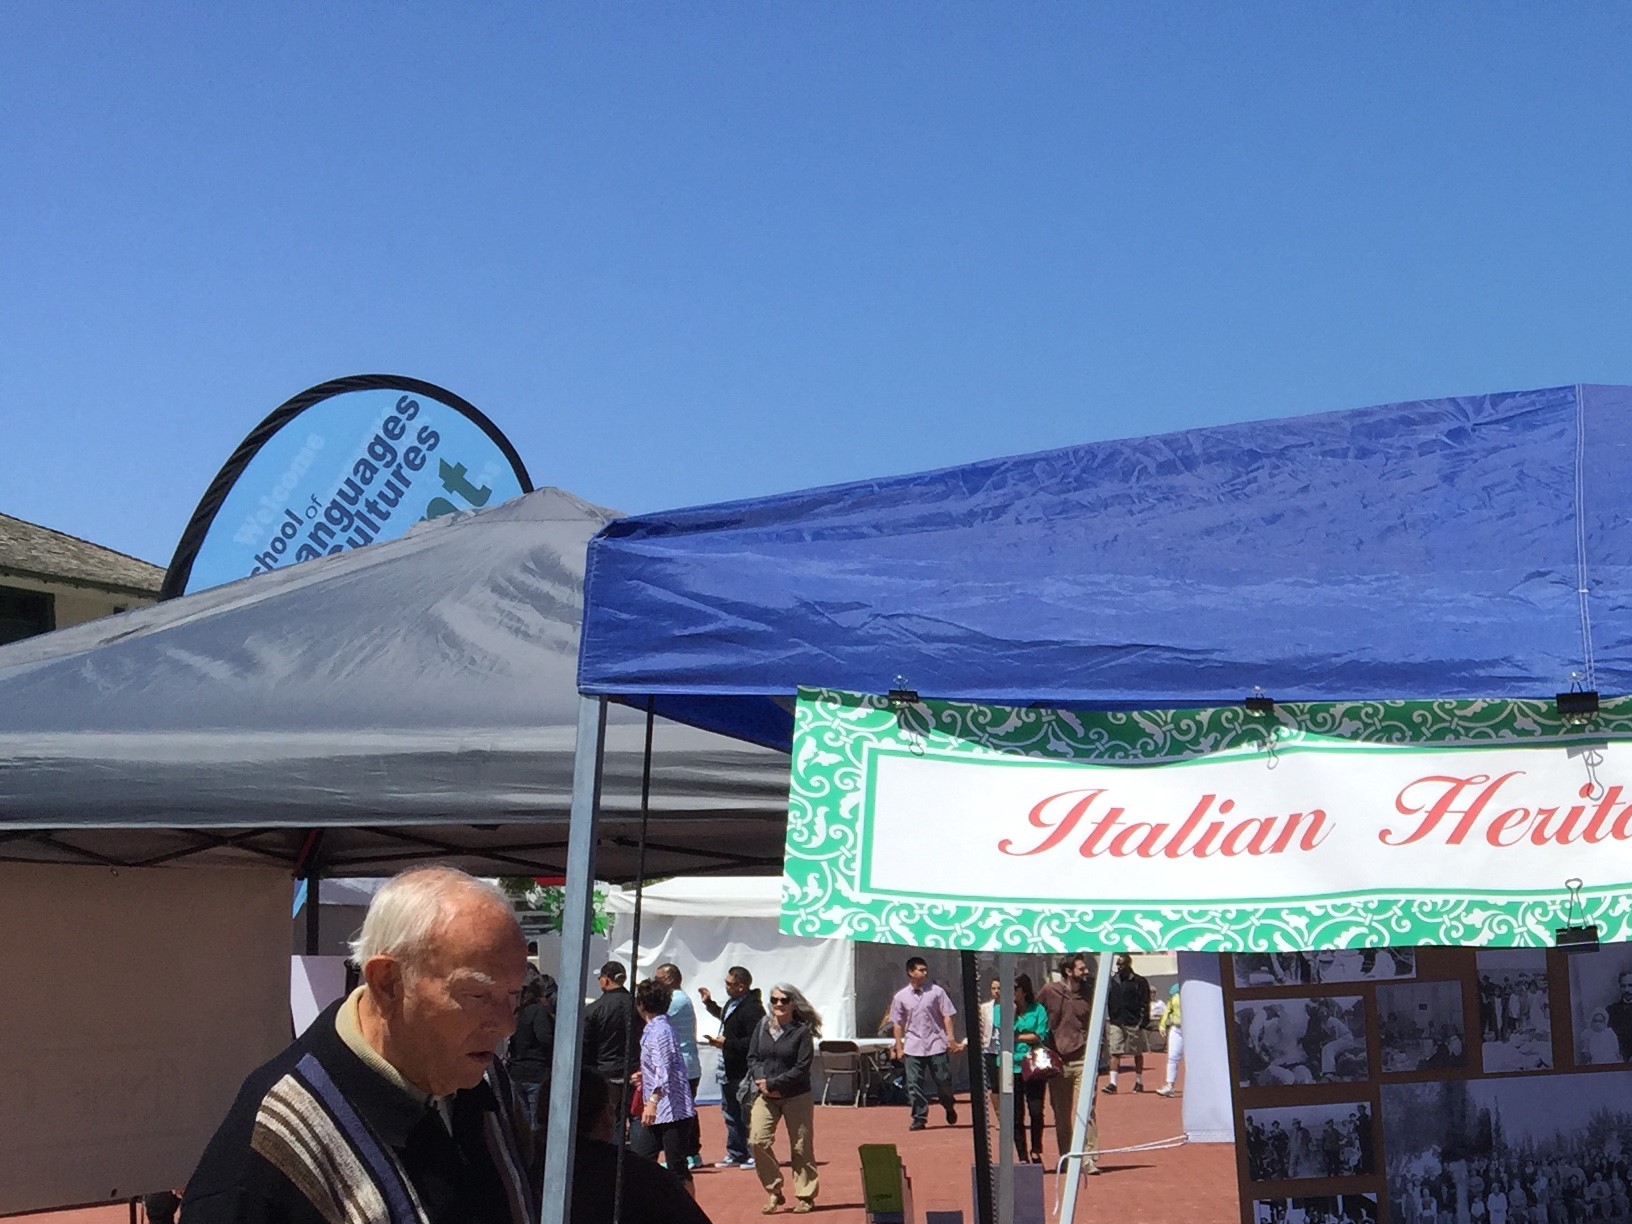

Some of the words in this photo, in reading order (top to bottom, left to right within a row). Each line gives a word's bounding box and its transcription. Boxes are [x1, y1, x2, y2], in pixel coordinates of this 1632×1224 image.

[295, 394, 420, 562] anguages
[250, 508, 304, 577] chool
[305, 493, 324, 520] of
[998, 788, 1336, 859] Italian
